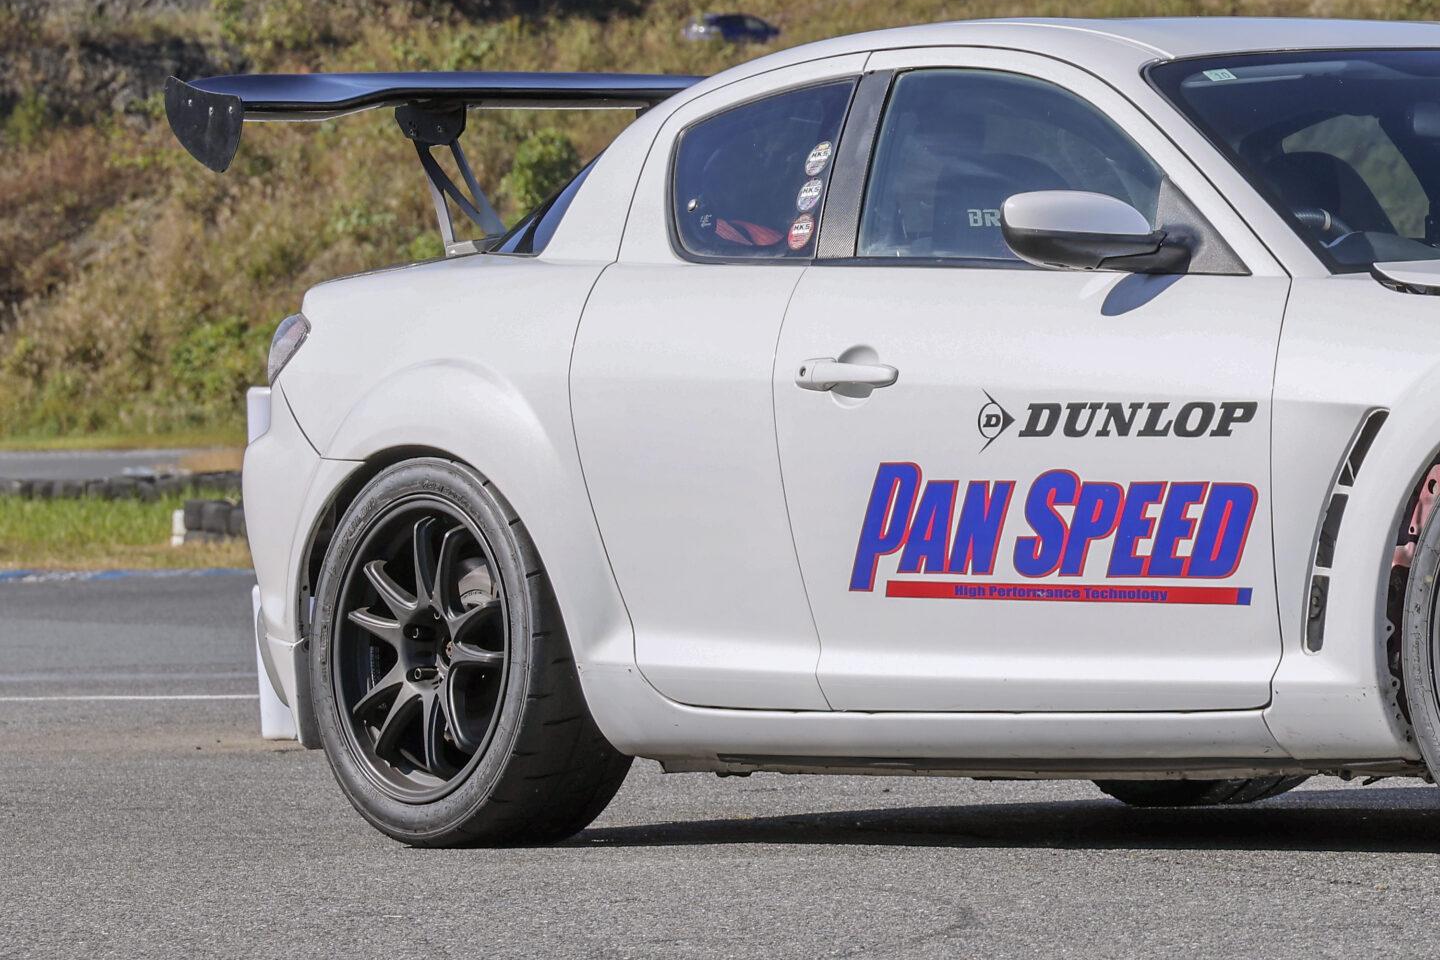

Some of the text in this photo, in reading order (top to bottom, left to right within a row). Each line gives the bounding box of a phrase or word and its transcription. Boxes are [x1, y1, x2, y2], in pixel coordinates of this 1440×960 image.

[1018, 401, 1259, 438] DUNLOP
[849, 462, 1259, 592] PAN SPEED
[954, 585, 986, 598] High
[1085, 588, 1168, 601] Technology
